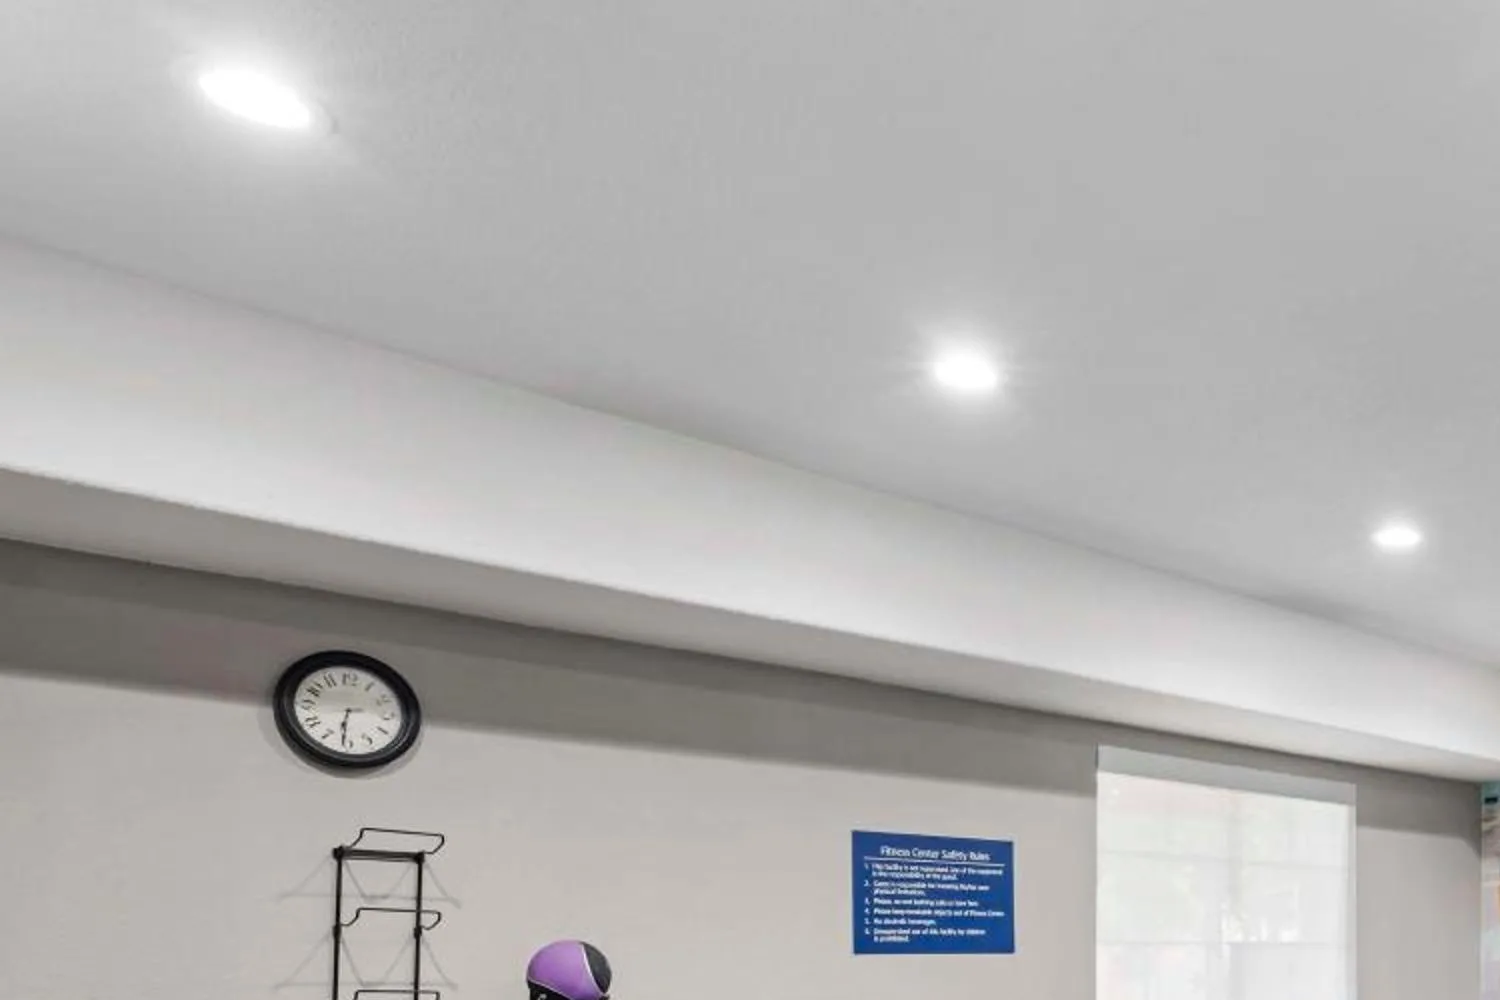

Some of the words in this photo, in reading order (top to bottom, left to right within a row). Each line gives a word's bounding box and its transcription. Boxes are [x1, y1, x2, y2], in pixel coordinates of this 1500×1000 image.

[880, 845, 910, 857] Fitness
[911, 847, 939, 859] Center
[941, 849, 967, 861] Safety
[969, 851, 991, 861] Rules
